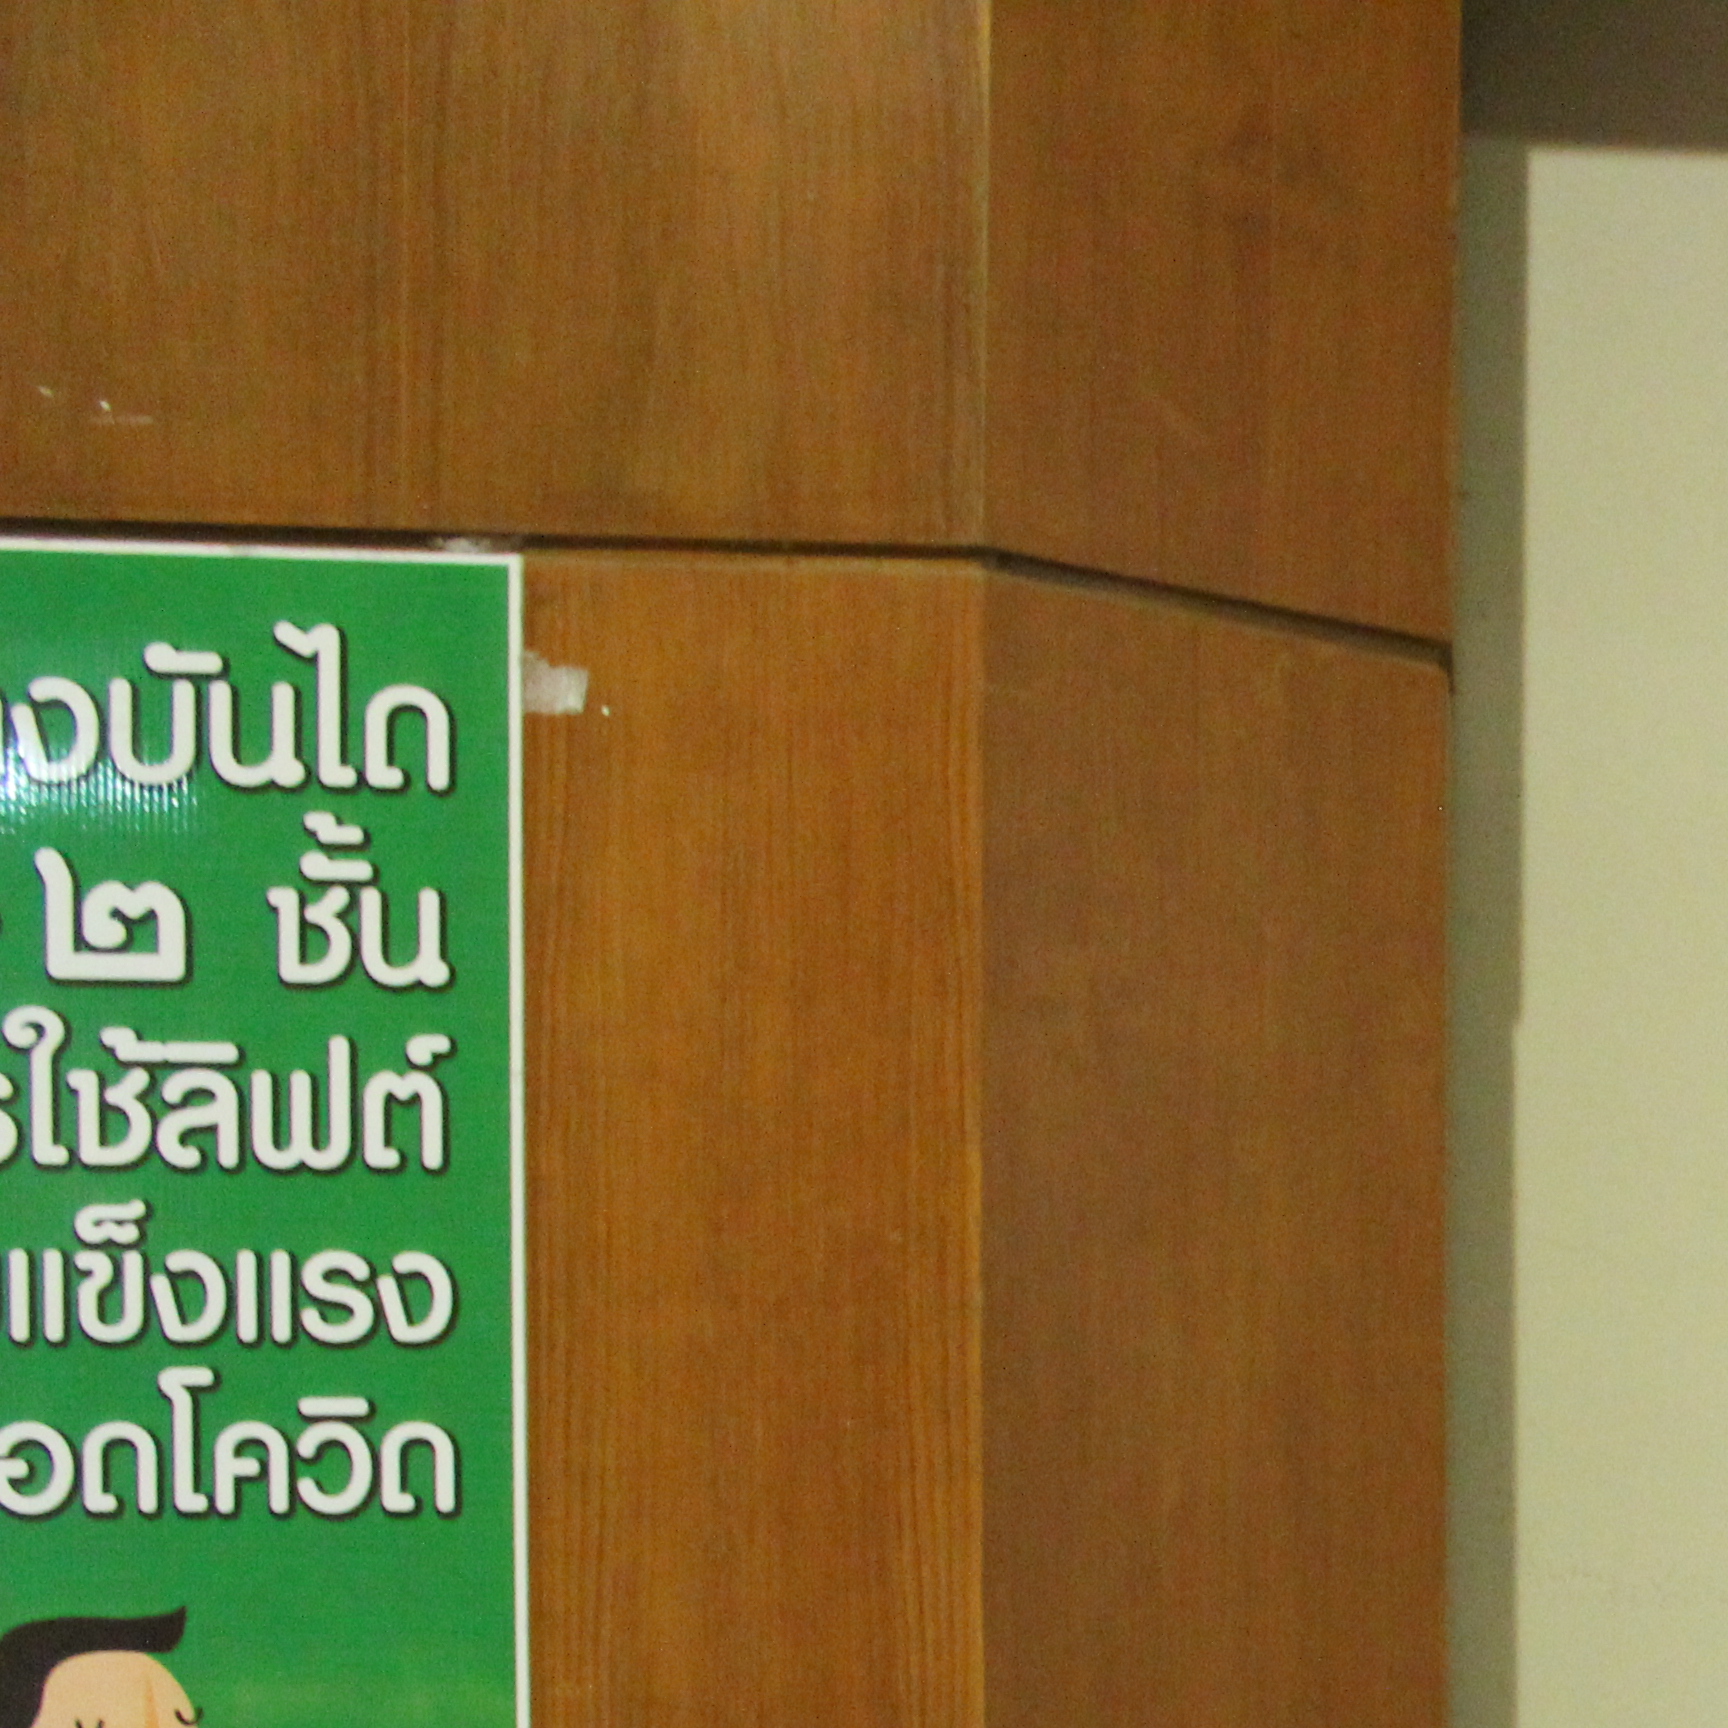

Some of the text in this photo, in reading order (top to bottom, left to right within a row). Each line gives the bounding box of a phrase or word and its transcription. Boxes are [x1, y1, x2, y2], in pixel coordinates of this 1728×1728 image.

[0, 621, 450, 790] งบันได
[35, 811, 452, 987] ๒ ชั้น
[0, 1003, 452, 1171] ใช้ลิฟต์
[8, 1199, 454, 1344] แข็งแรง
[0, 1368, 457, 1516] อดโควิด
